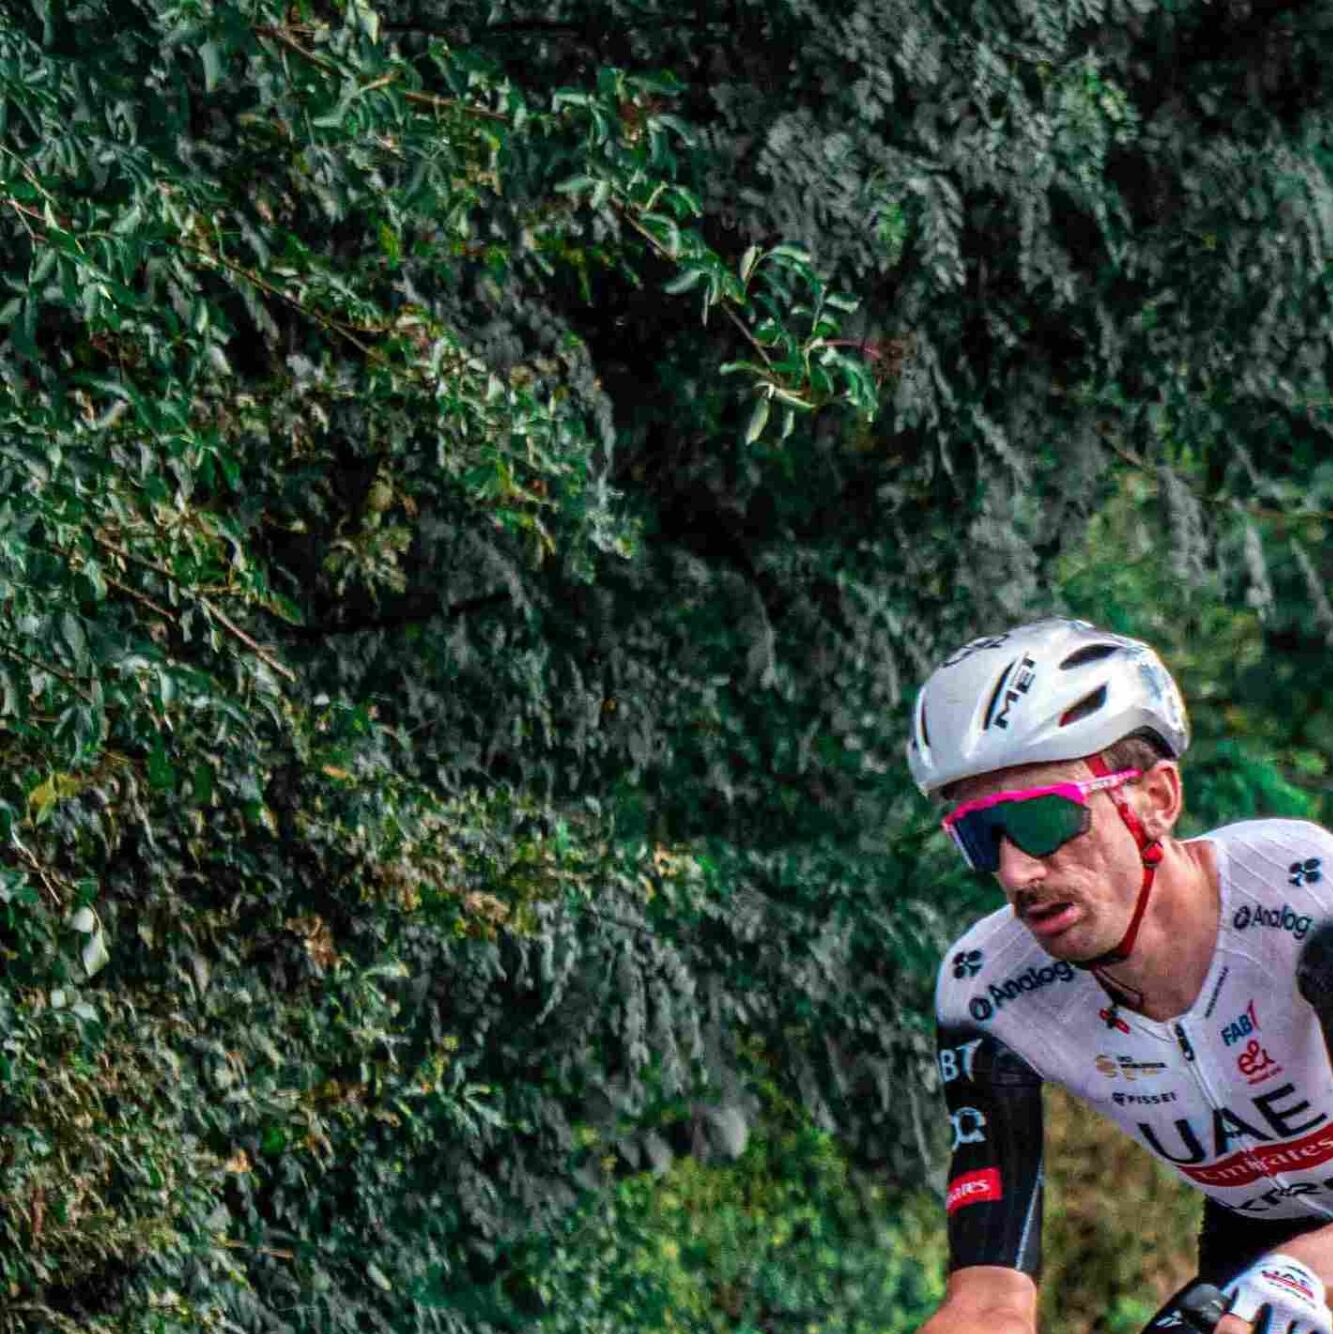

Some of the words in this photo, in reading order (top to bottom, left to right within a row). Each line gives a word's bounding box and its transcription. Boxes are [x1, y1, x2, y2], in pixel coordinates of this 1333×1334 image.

[994, 656, 1036, 730] MET
[1250, 903, 1313, 941] Analog
[987, 958, 1076, 1004] Analog
[1137, 1082, 1328, 1165] UAE
